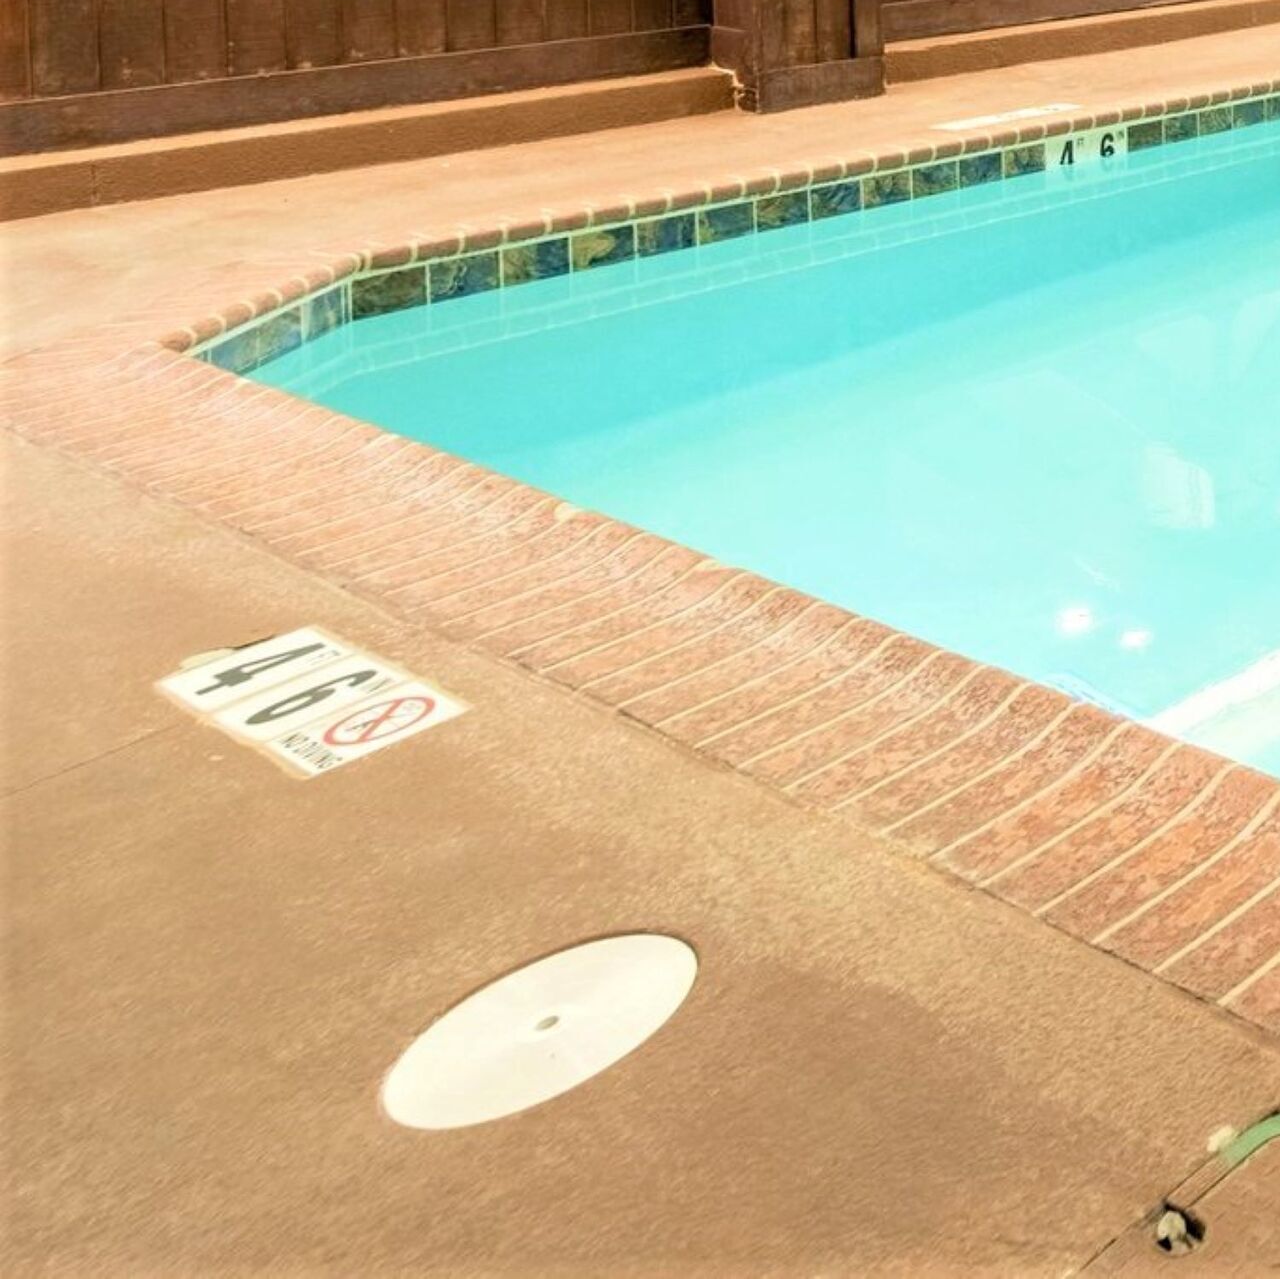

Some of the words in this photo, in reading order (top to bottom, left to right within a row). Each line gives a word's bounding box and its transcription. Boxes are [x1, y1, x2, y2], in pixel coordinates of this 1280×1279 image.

[1100, 132, 1115, 158] 6
[194, 642, 326, 697] 4
[245, 670, 378, 725] 6
[293, 740, 344, 769] DIVING
